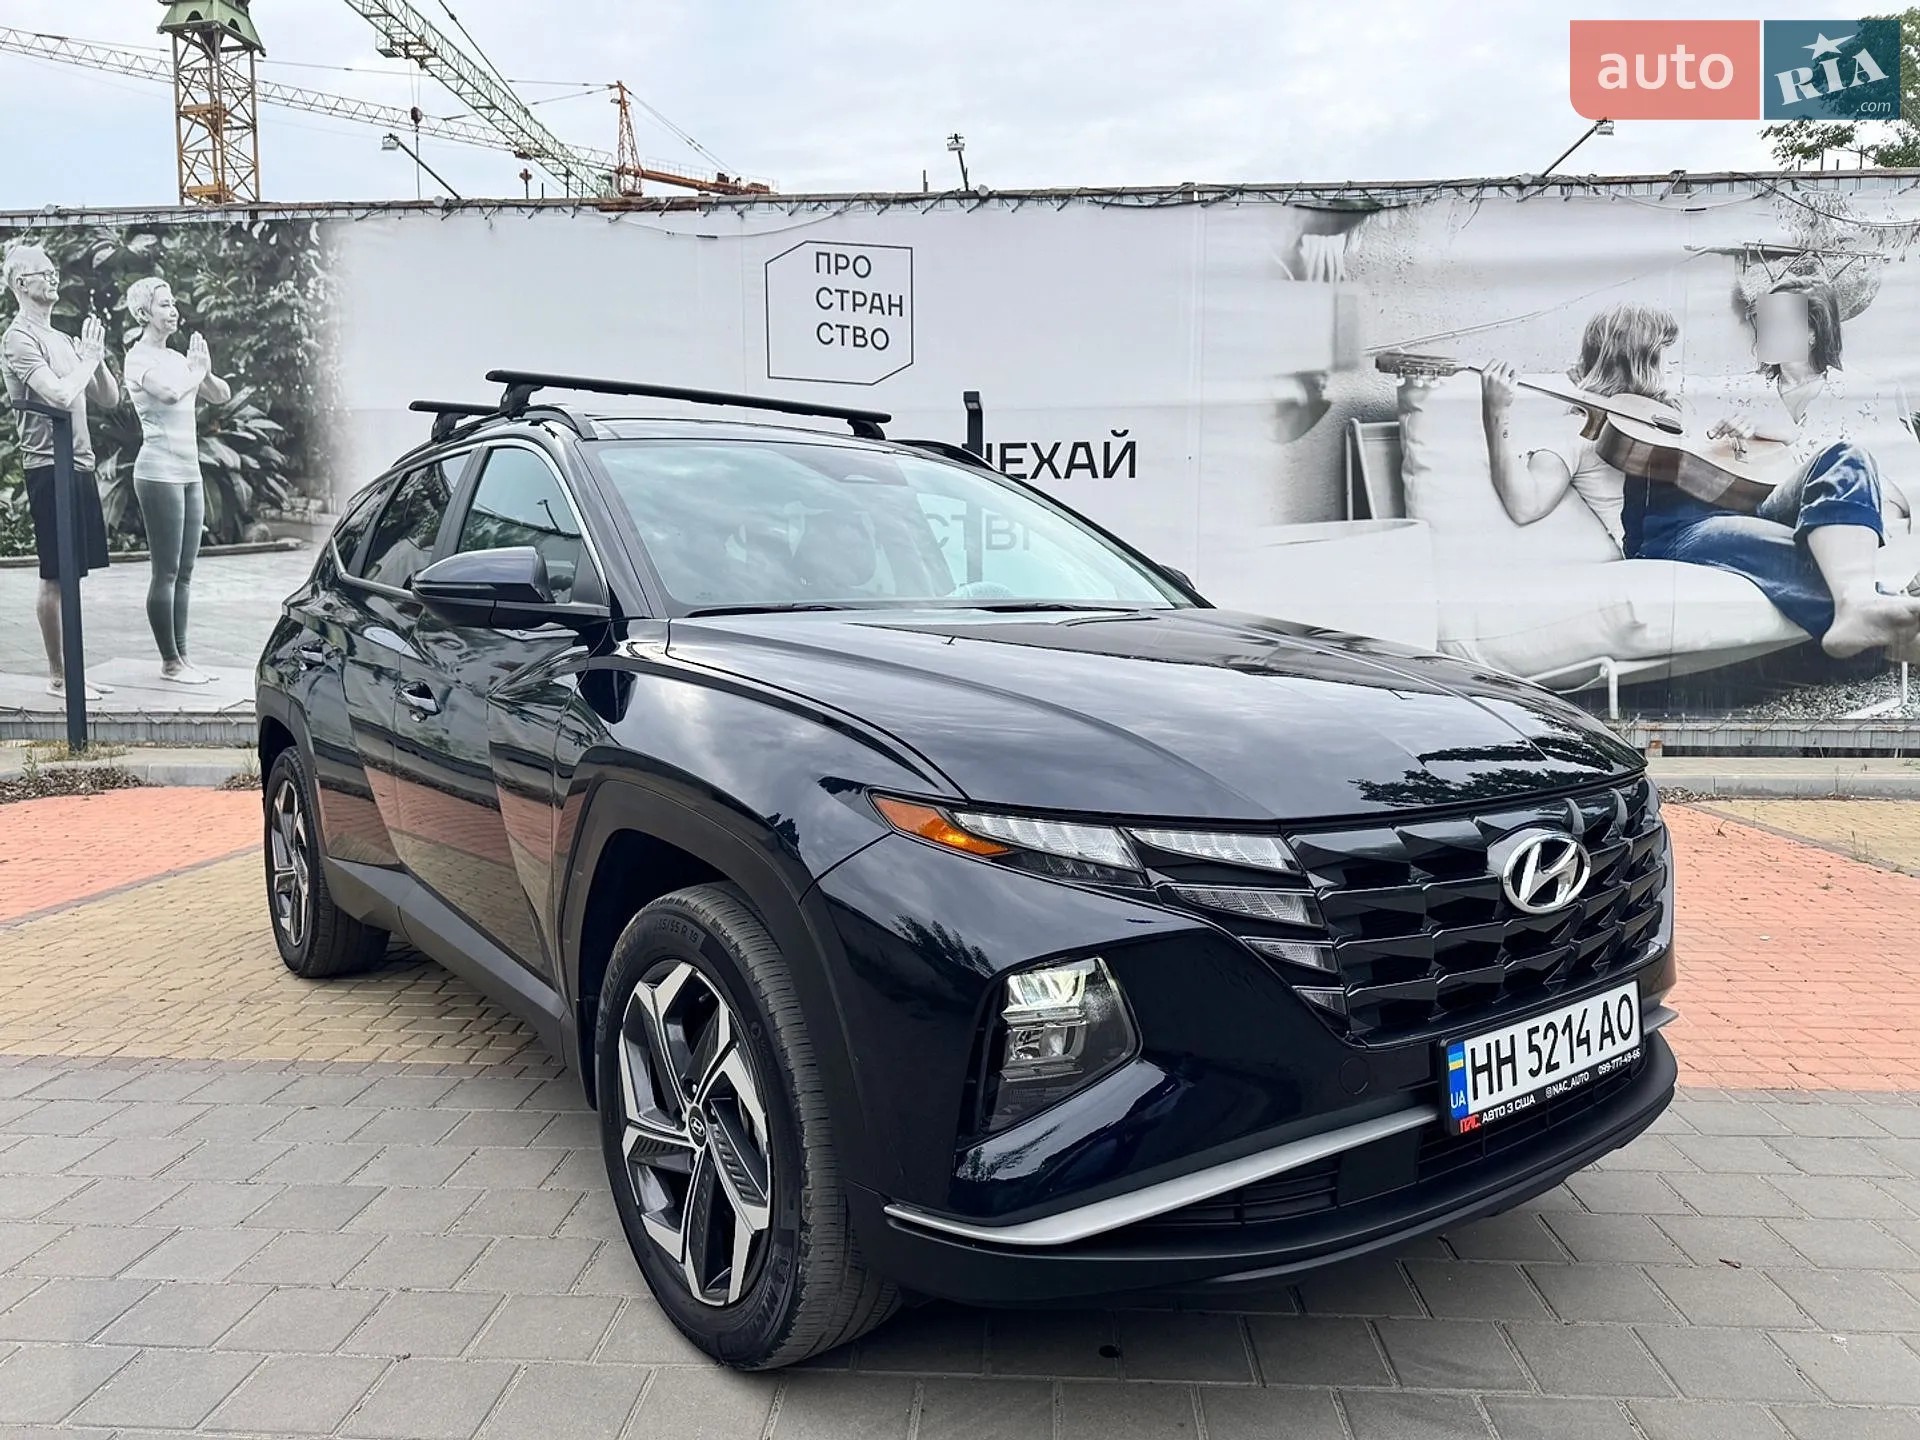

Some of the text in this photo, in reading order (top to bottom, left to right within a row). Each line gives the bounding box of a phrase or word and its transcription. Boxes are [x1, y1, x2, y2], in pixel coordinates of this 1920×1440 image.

[815, 251, 872, 279] ПРО
[815, 286, 904, 318] СТРАН
[816, 321, 890, 351] СТВО
[1527, 1008, 1591, 1078] 5214
[1450, 1090, 1466, 1108] UA
[1482, 1105, 1506, 1123] АВТО
[1514, 1094, 1536, 1111] США
